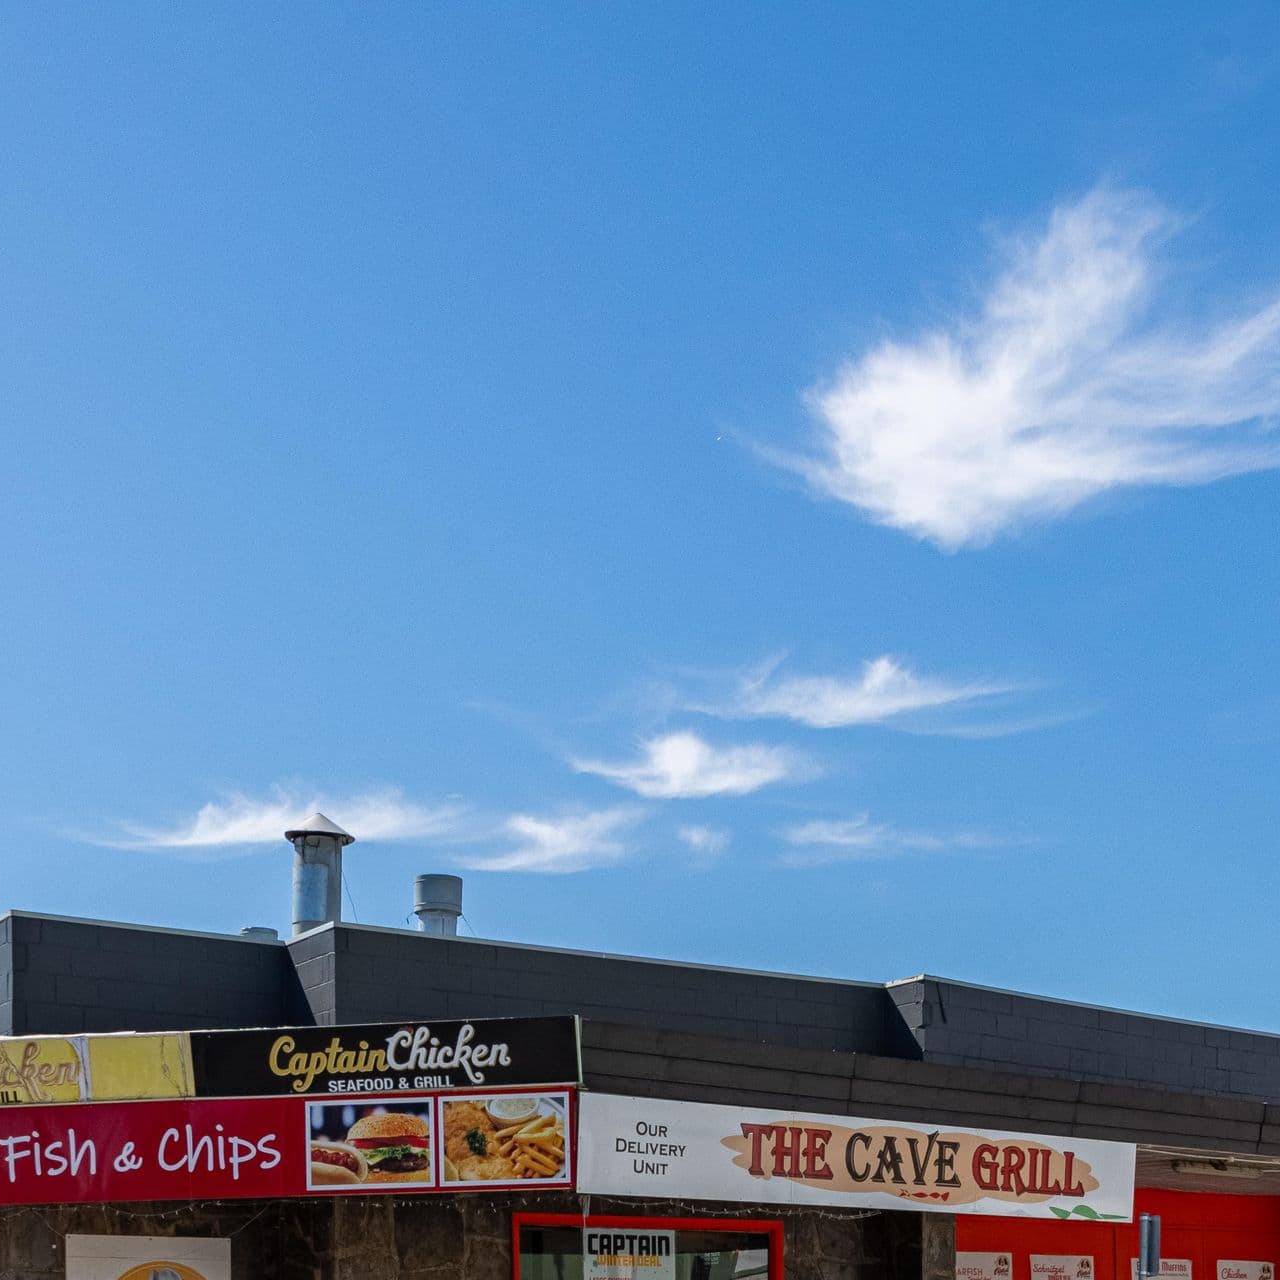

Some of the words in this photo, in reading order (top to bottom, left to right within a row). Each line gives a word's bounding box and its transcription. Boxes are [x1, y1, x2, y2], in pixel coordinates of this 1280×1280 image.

[328, 1077, 394, 1093] SEAFOOD
[398, 1077, 409, 1089] &
[414, 1075, 455, 1089] GRILL
[636, 1121, 668, 1138] OUR
[113, 1141, 143, 1172] &
[157, 1124, 282, 1180] Chips
[615, 1138, 687, 1157] DELIVERY
[633, 1159, 669, 1176] UNIT
[740, 1122, 834, 1180] THE
[845, 1130, 962, 1188] CAVE
[971, 1143, 1085, 1197] GRILL
[587, 1233, 670, 1256] CAPTAIN
